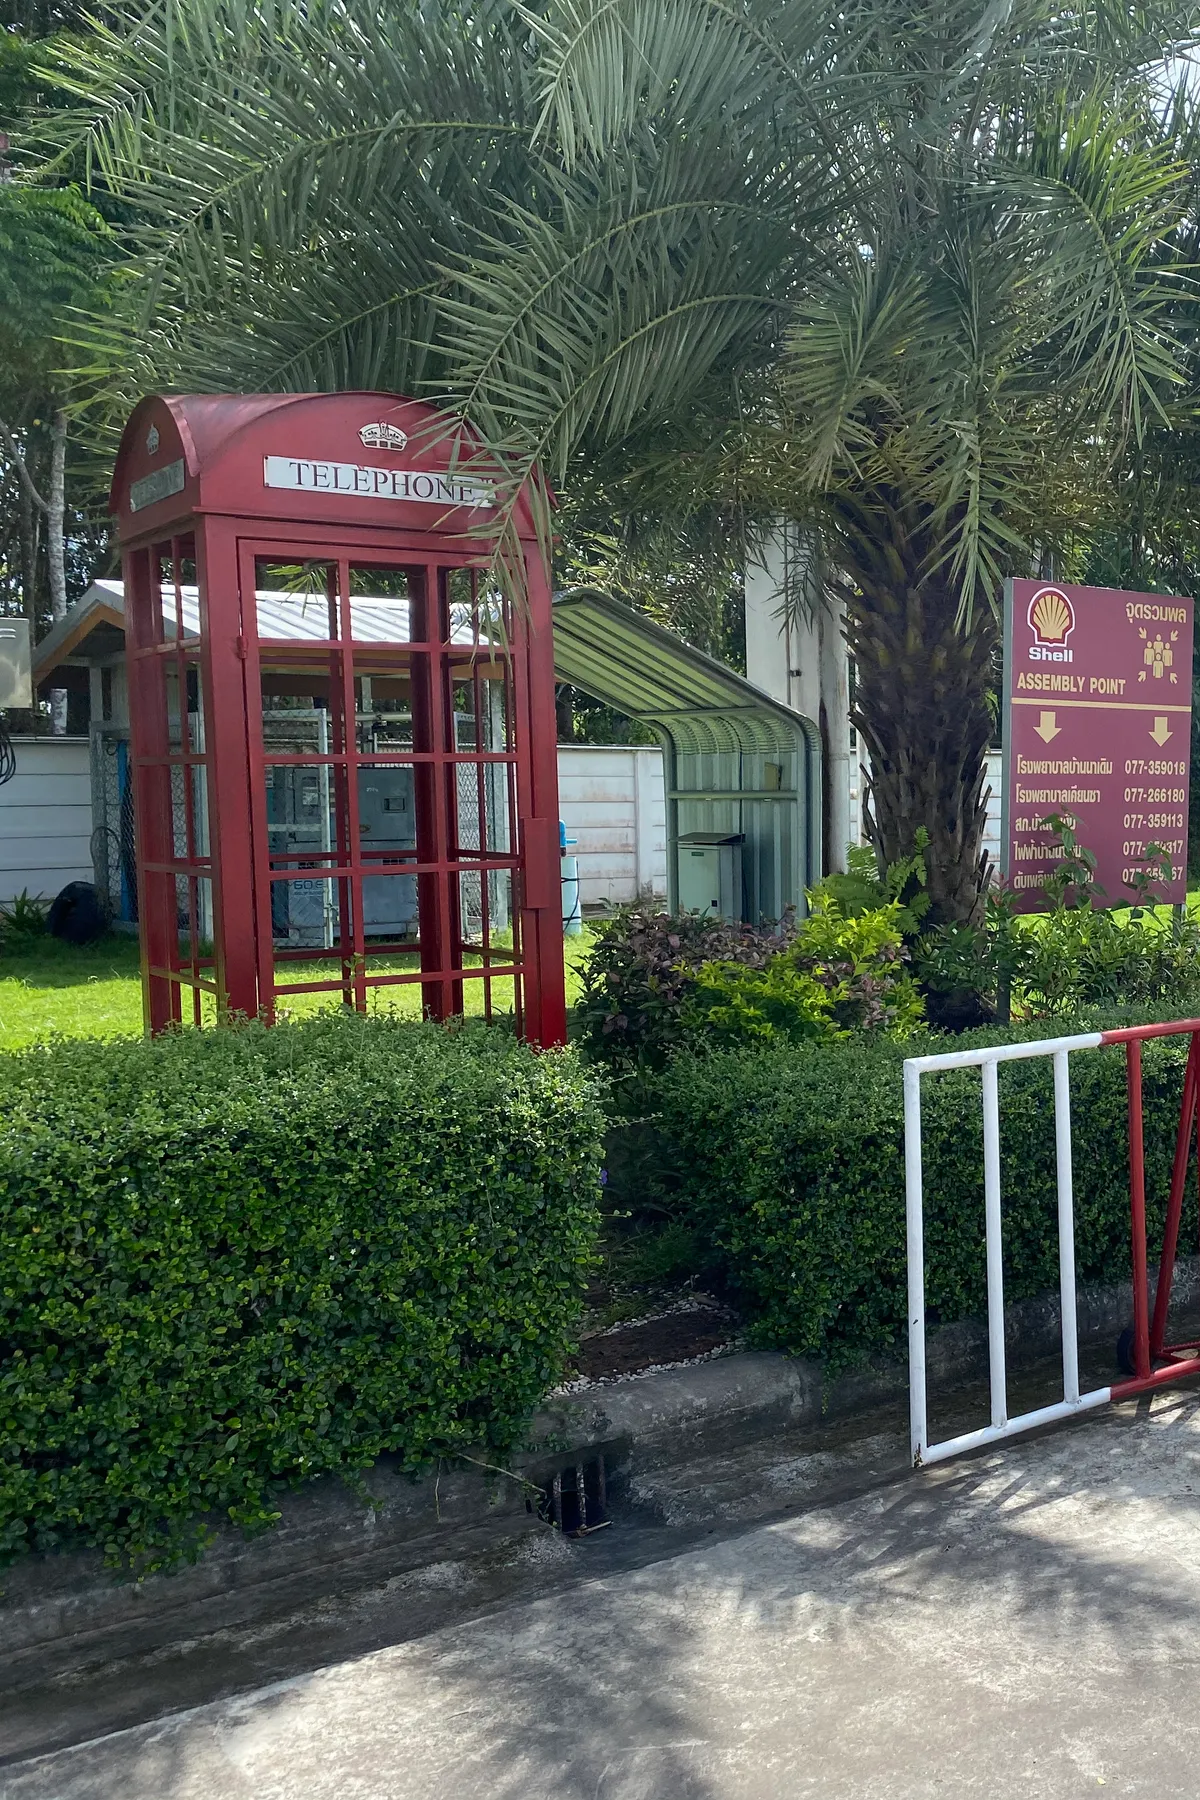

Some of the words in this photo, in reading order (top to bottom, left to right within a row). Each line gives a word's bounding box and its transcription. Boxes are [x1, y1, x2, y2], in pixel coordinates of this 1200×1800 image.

[288, 462, 475, 503] TELEPHONE
[1125, 602, 1187, 624] จุดรวมพล
[1028, 646, 1073, 662] Shell
[1017, 672, 1085, 693] ASSEMBLY
[1089, 677, 1126, 695] POINT
[1017, 753, 1113, 775] โรงพยาบาลบ้านนาเดิม
[1124, 760, 1186, 775] 077-359018
[1124, 788, 1185, 803] 077-266180
[1123, 813, 1183, 829] 077-359113
